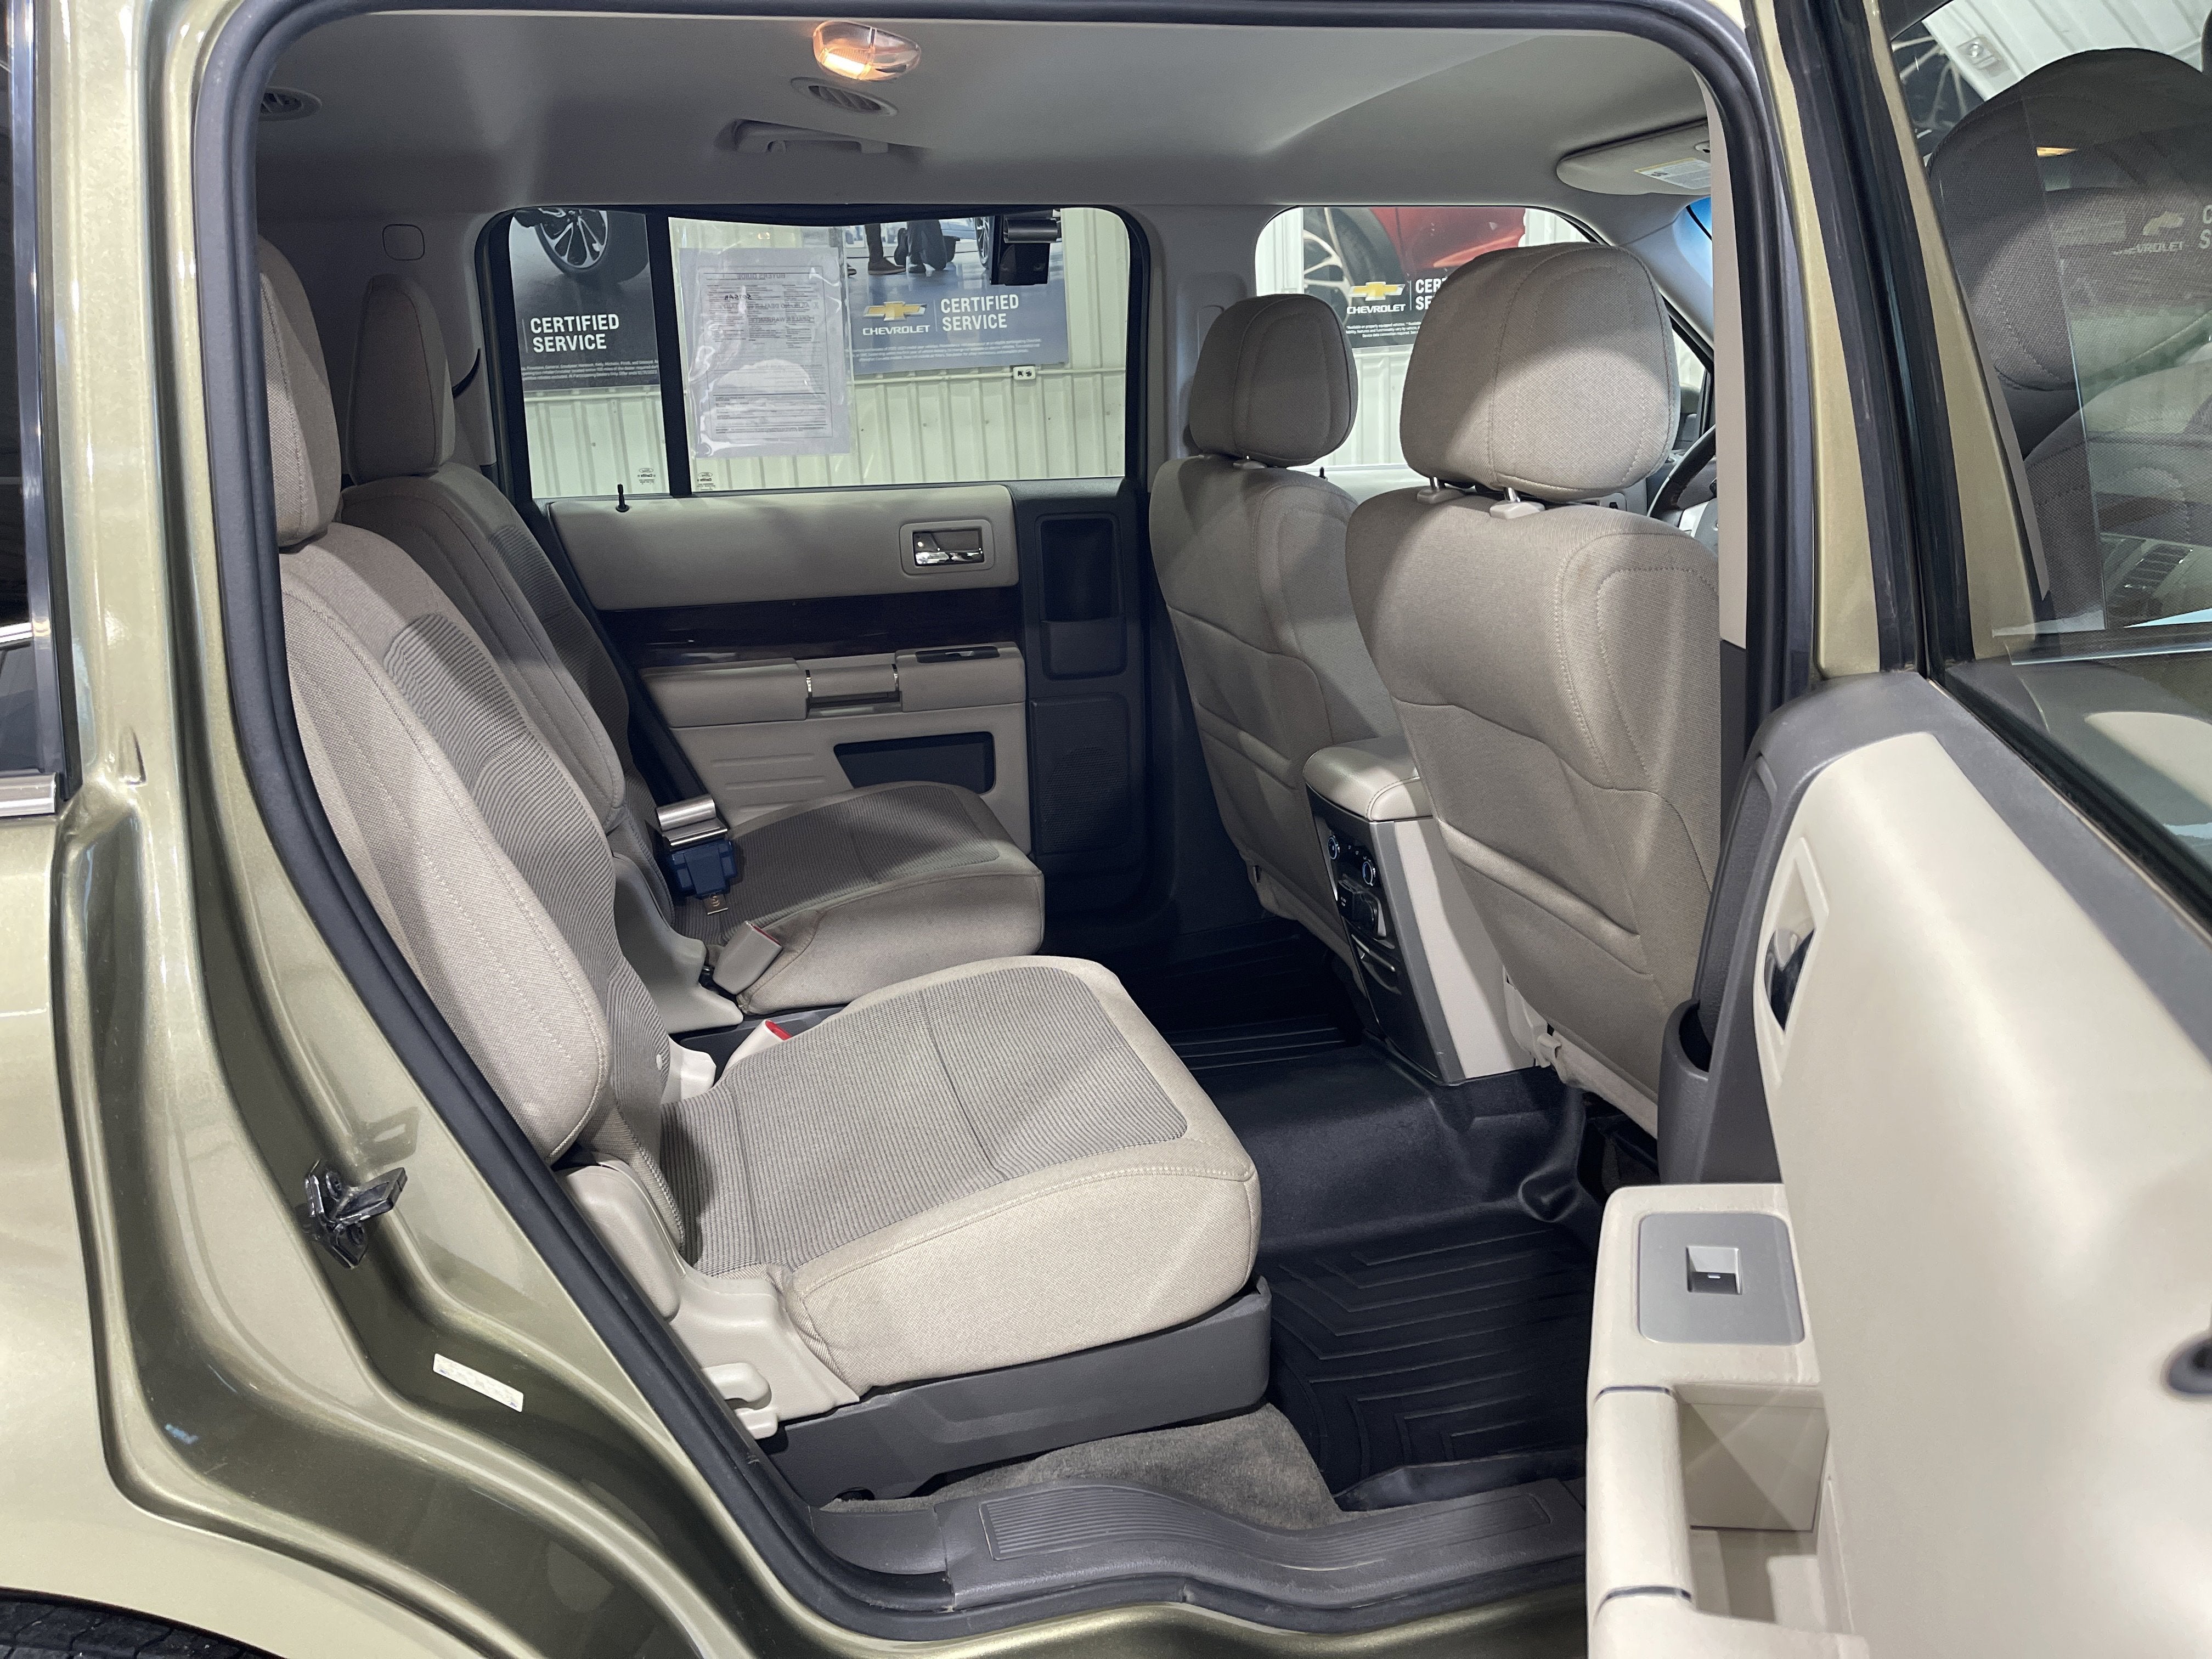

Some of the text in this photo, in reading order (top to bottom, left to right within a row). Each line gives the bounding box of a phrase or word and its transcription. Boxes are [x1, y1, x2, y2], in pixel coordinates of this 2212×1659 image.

[940, 294, 1019, 313] CERTIFIED
[1346, 304, 1406, 314] CHEVROLET
[530, 314, 619, 334] CERTIFIED
[862, 325, 930, 336] CHEVROLET
[942, 313, 1007, 331] SERVICE
[532, 334, 607, 353] SERVICE
